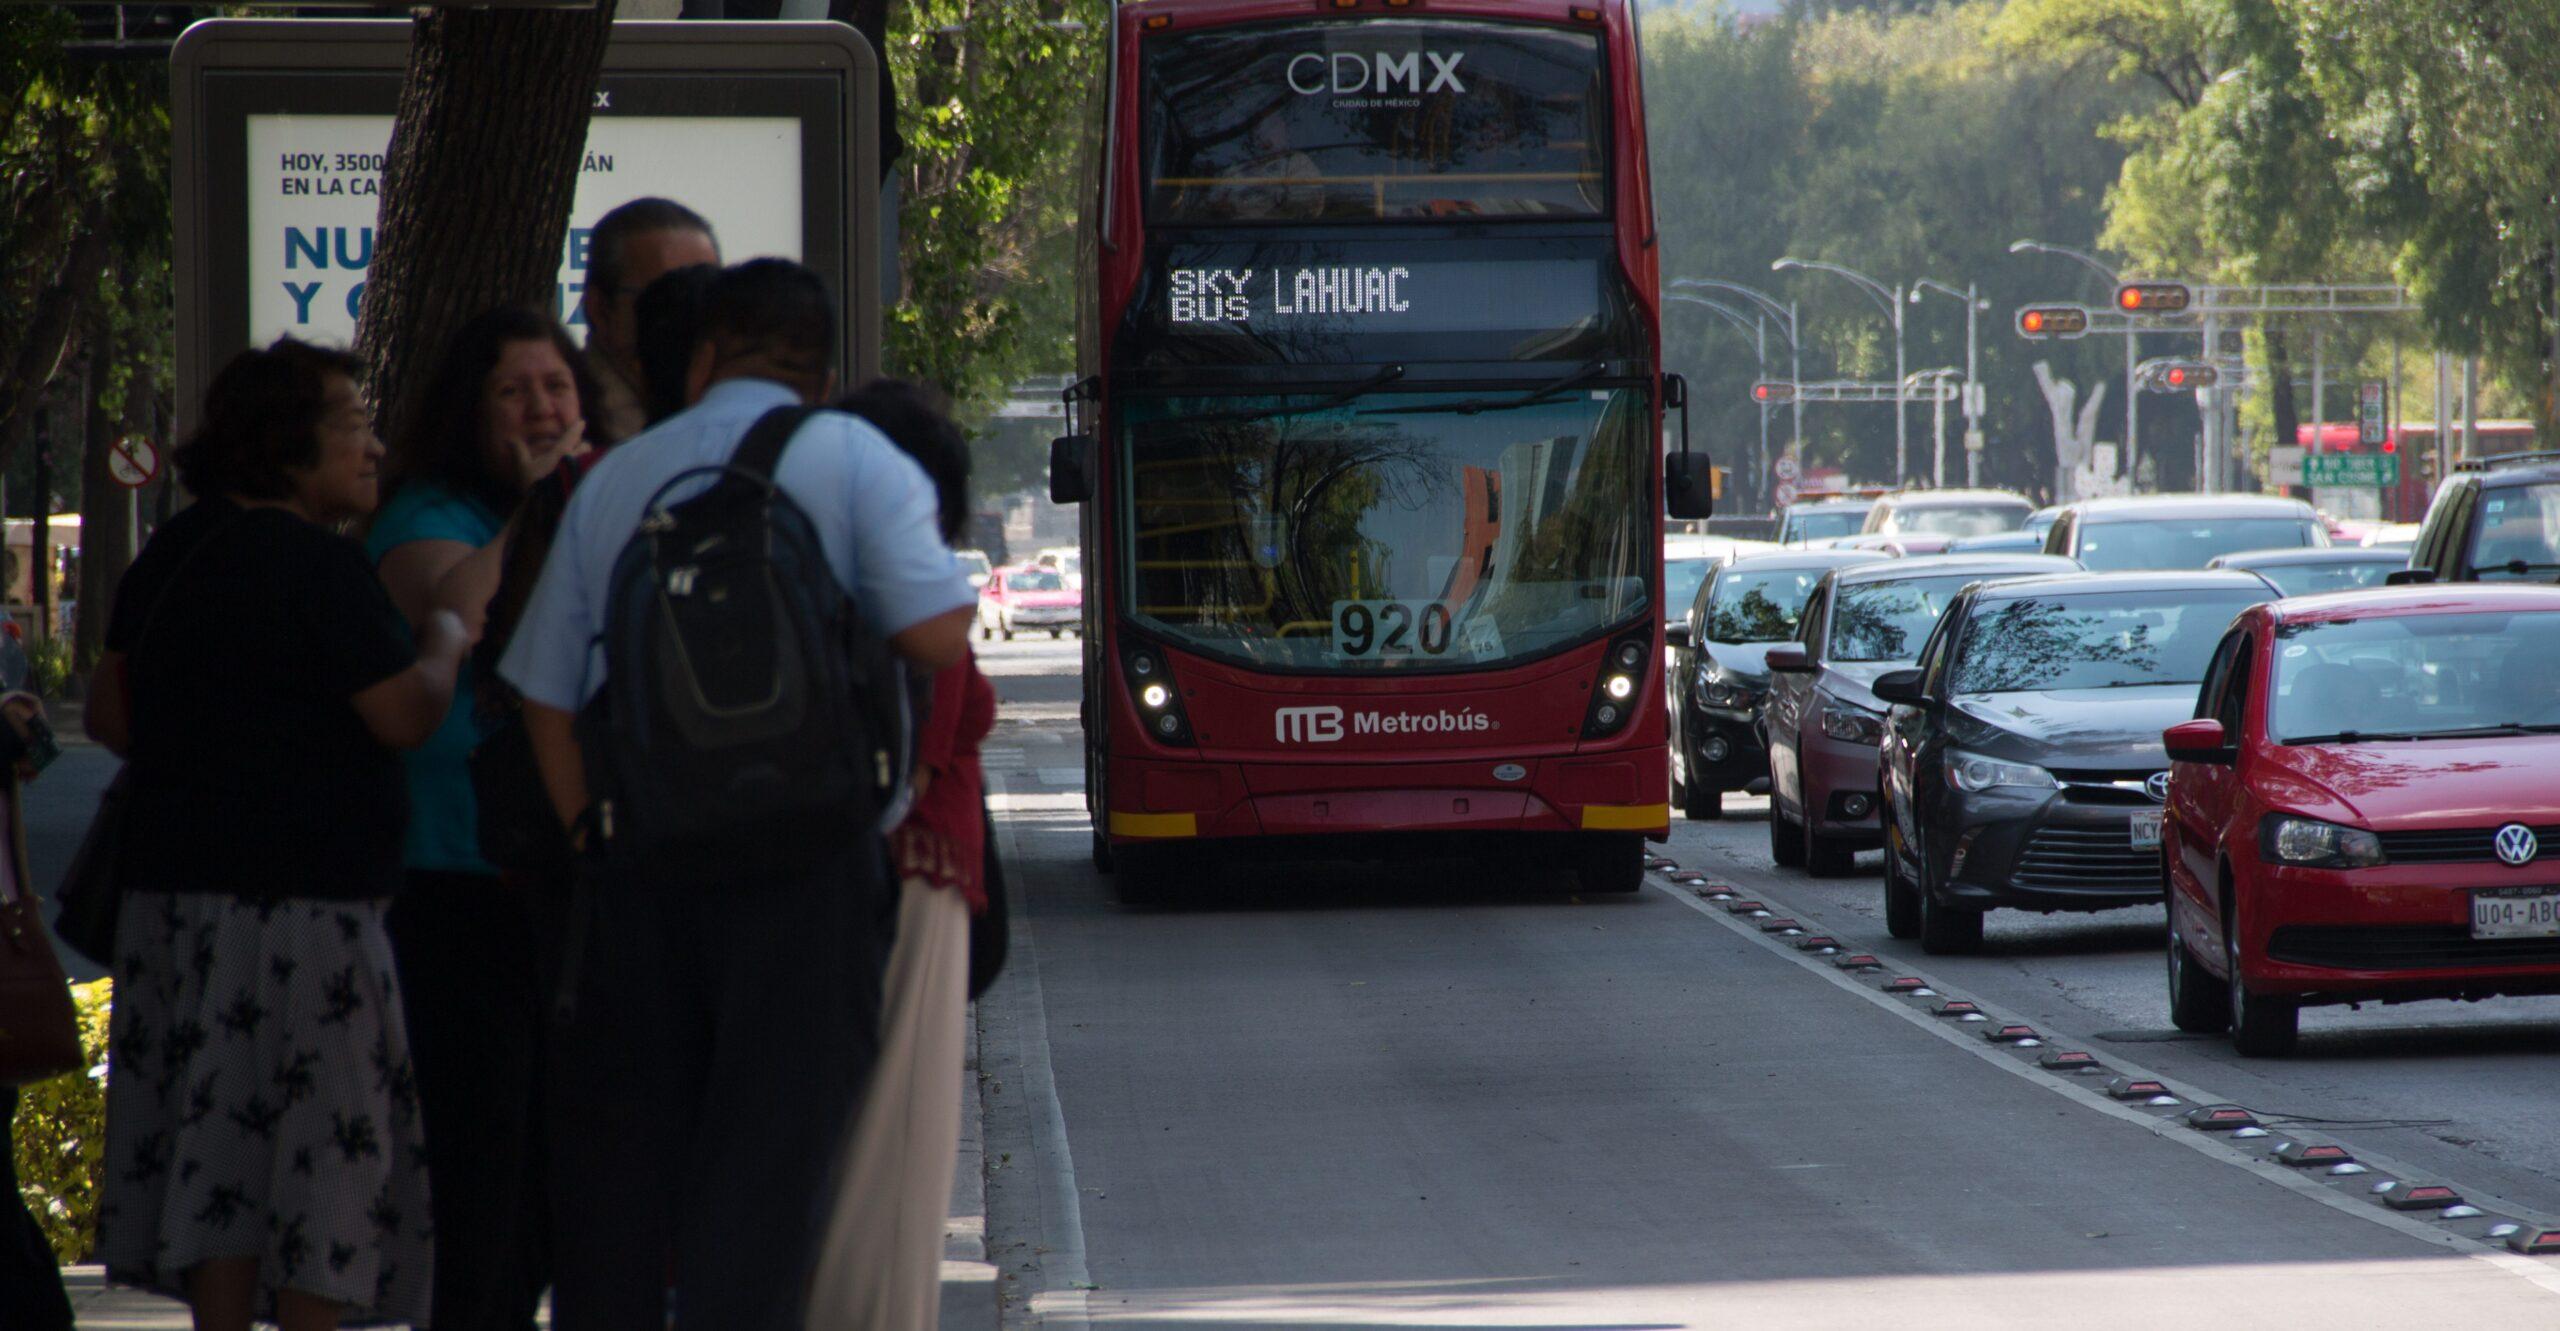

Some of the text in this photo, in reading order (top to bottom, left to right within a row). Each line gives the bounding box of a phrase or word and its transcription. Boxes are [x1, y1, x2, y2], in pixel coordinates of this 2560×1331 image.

[1287, 52, 1466, 95] CDMX
[1332, 99, 1368, 109] CIUDAD
[1370, 99, 1382, 108] DE
[281, 153, 328, 174] HOY,
[580, 151, 614, 172] ÁN
[282, 178, 384, 195] EN LA CA
[285, 227, 373, 270] NU
[282, 282, 323, 324] Y
[1171, 267, 1409, 314] SKY LAHUAC
[1172, 296, 1250, 322] BUS
[1340, 603, 1451, 656] 920
[1354, 706, 1489, 734] Metrobús
